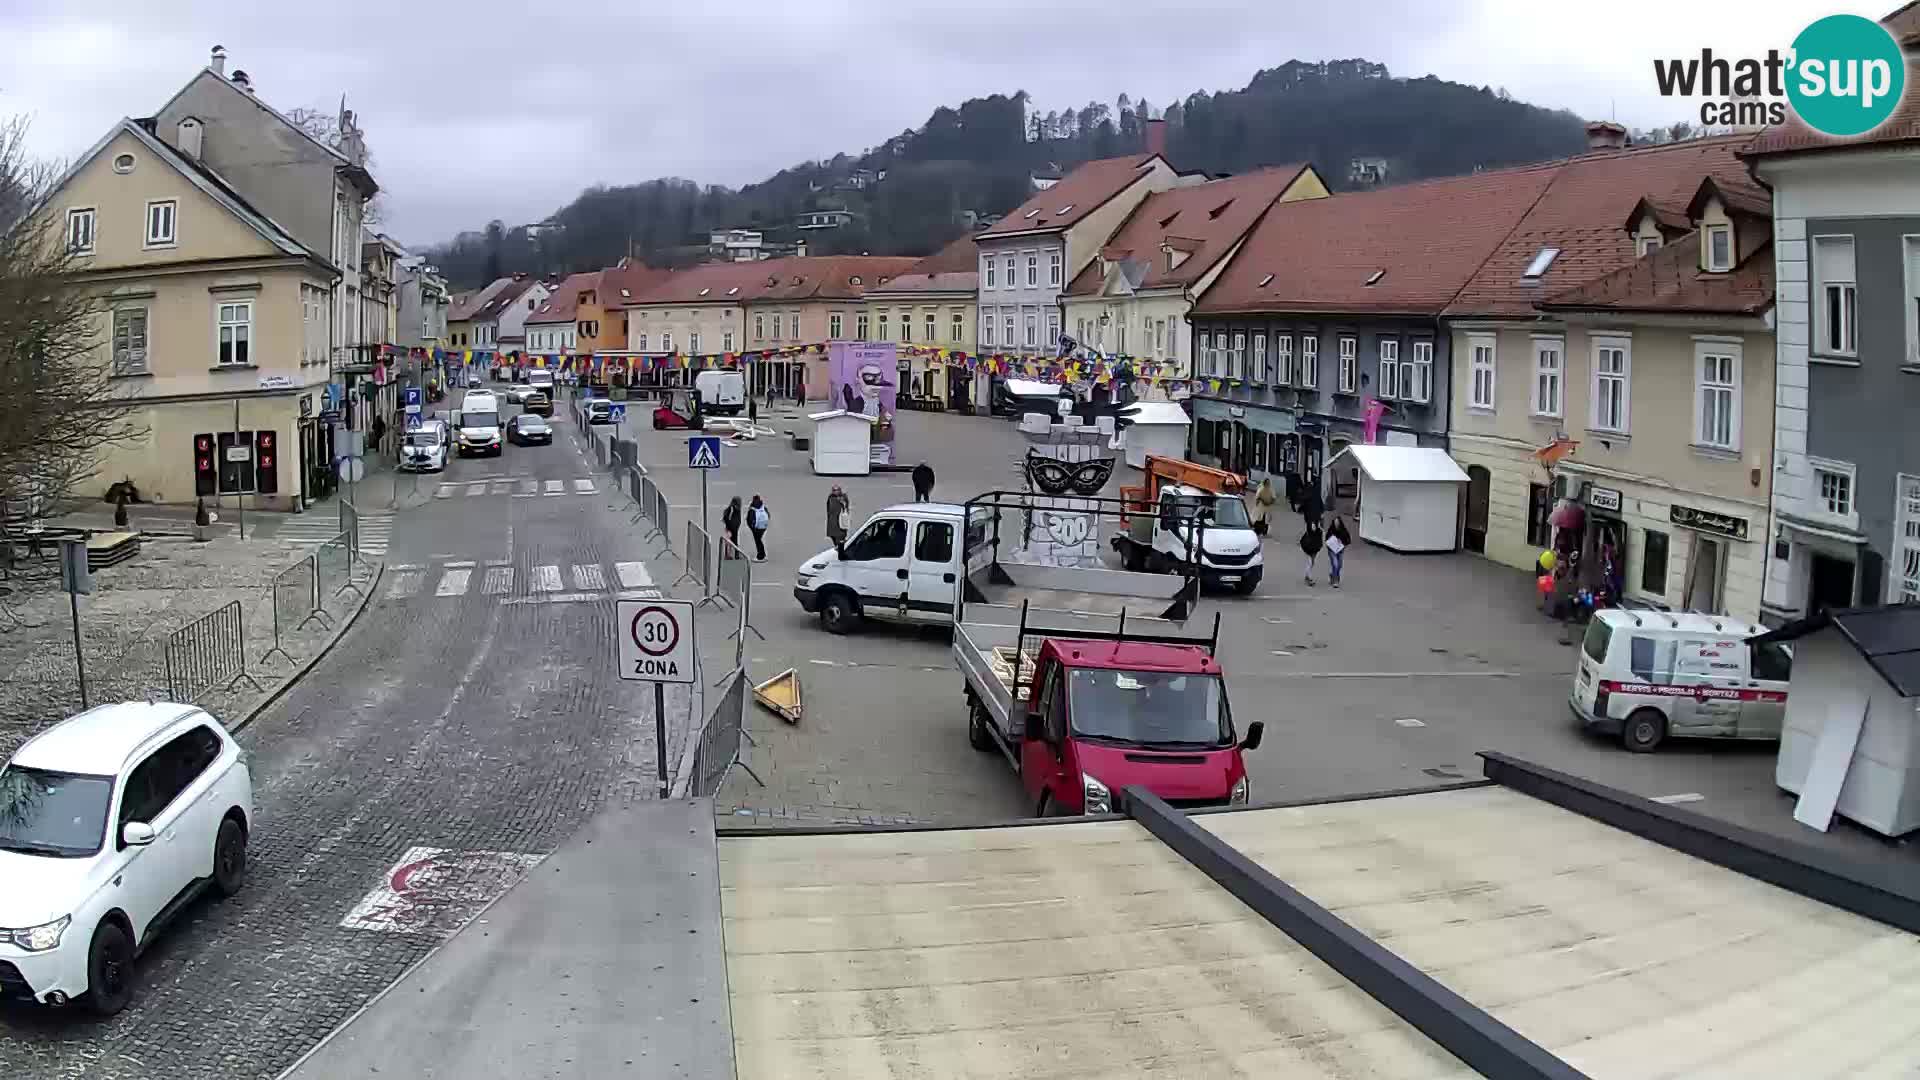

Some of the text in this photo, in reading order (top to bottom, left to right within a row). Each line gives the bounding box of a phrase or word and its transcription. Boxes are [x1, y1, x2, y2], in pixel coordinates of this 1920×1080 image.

[409, 391, 417, 402] P
[644, 622, 667, 643] 30
[634, 659, 678, 676] ZONA
